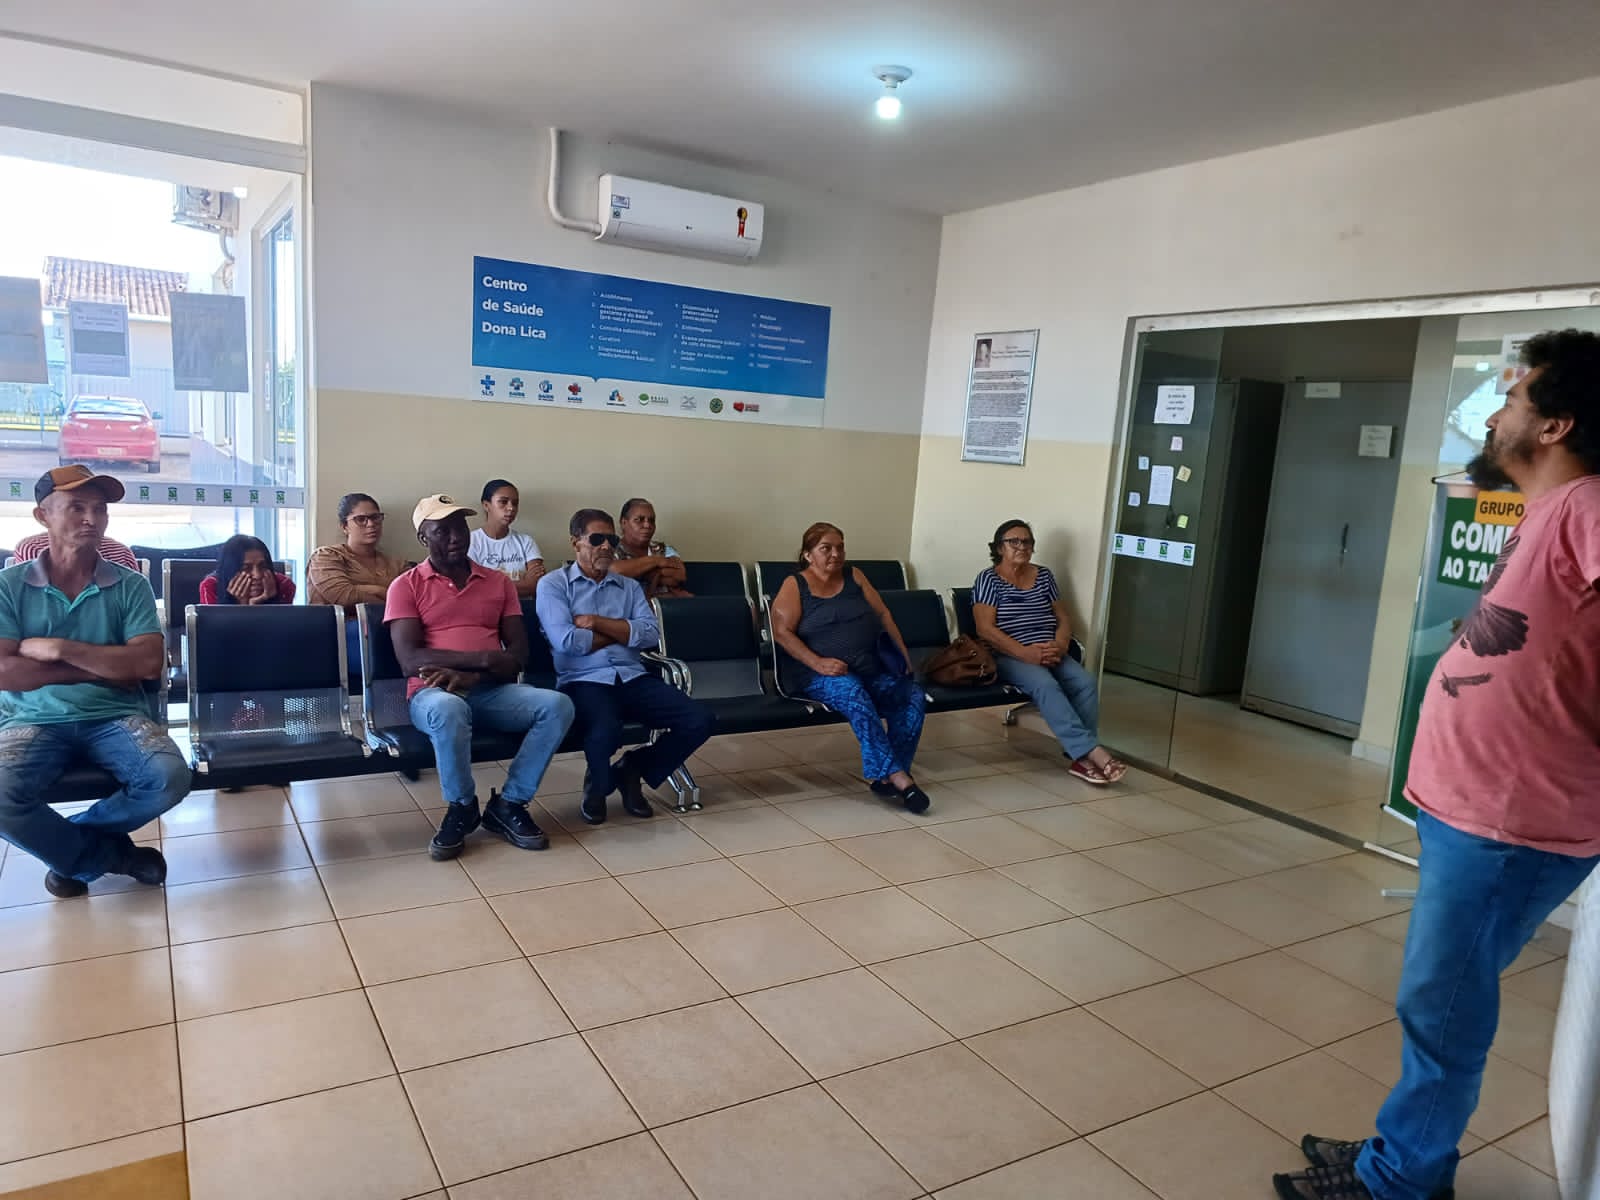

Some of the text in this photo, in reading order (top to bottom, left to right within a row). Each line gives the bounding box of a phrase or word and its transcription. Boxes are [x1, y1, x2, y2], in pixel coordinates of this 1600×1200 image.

[482, 275, 527, 292] Centro
[482, 298, 544, 317] de Saúde
[482, 321, 546, 339] Dona Lica
[1479, 501, 1525, 517] GRUPO
[1442, 556, 1496, 583] AO TA
